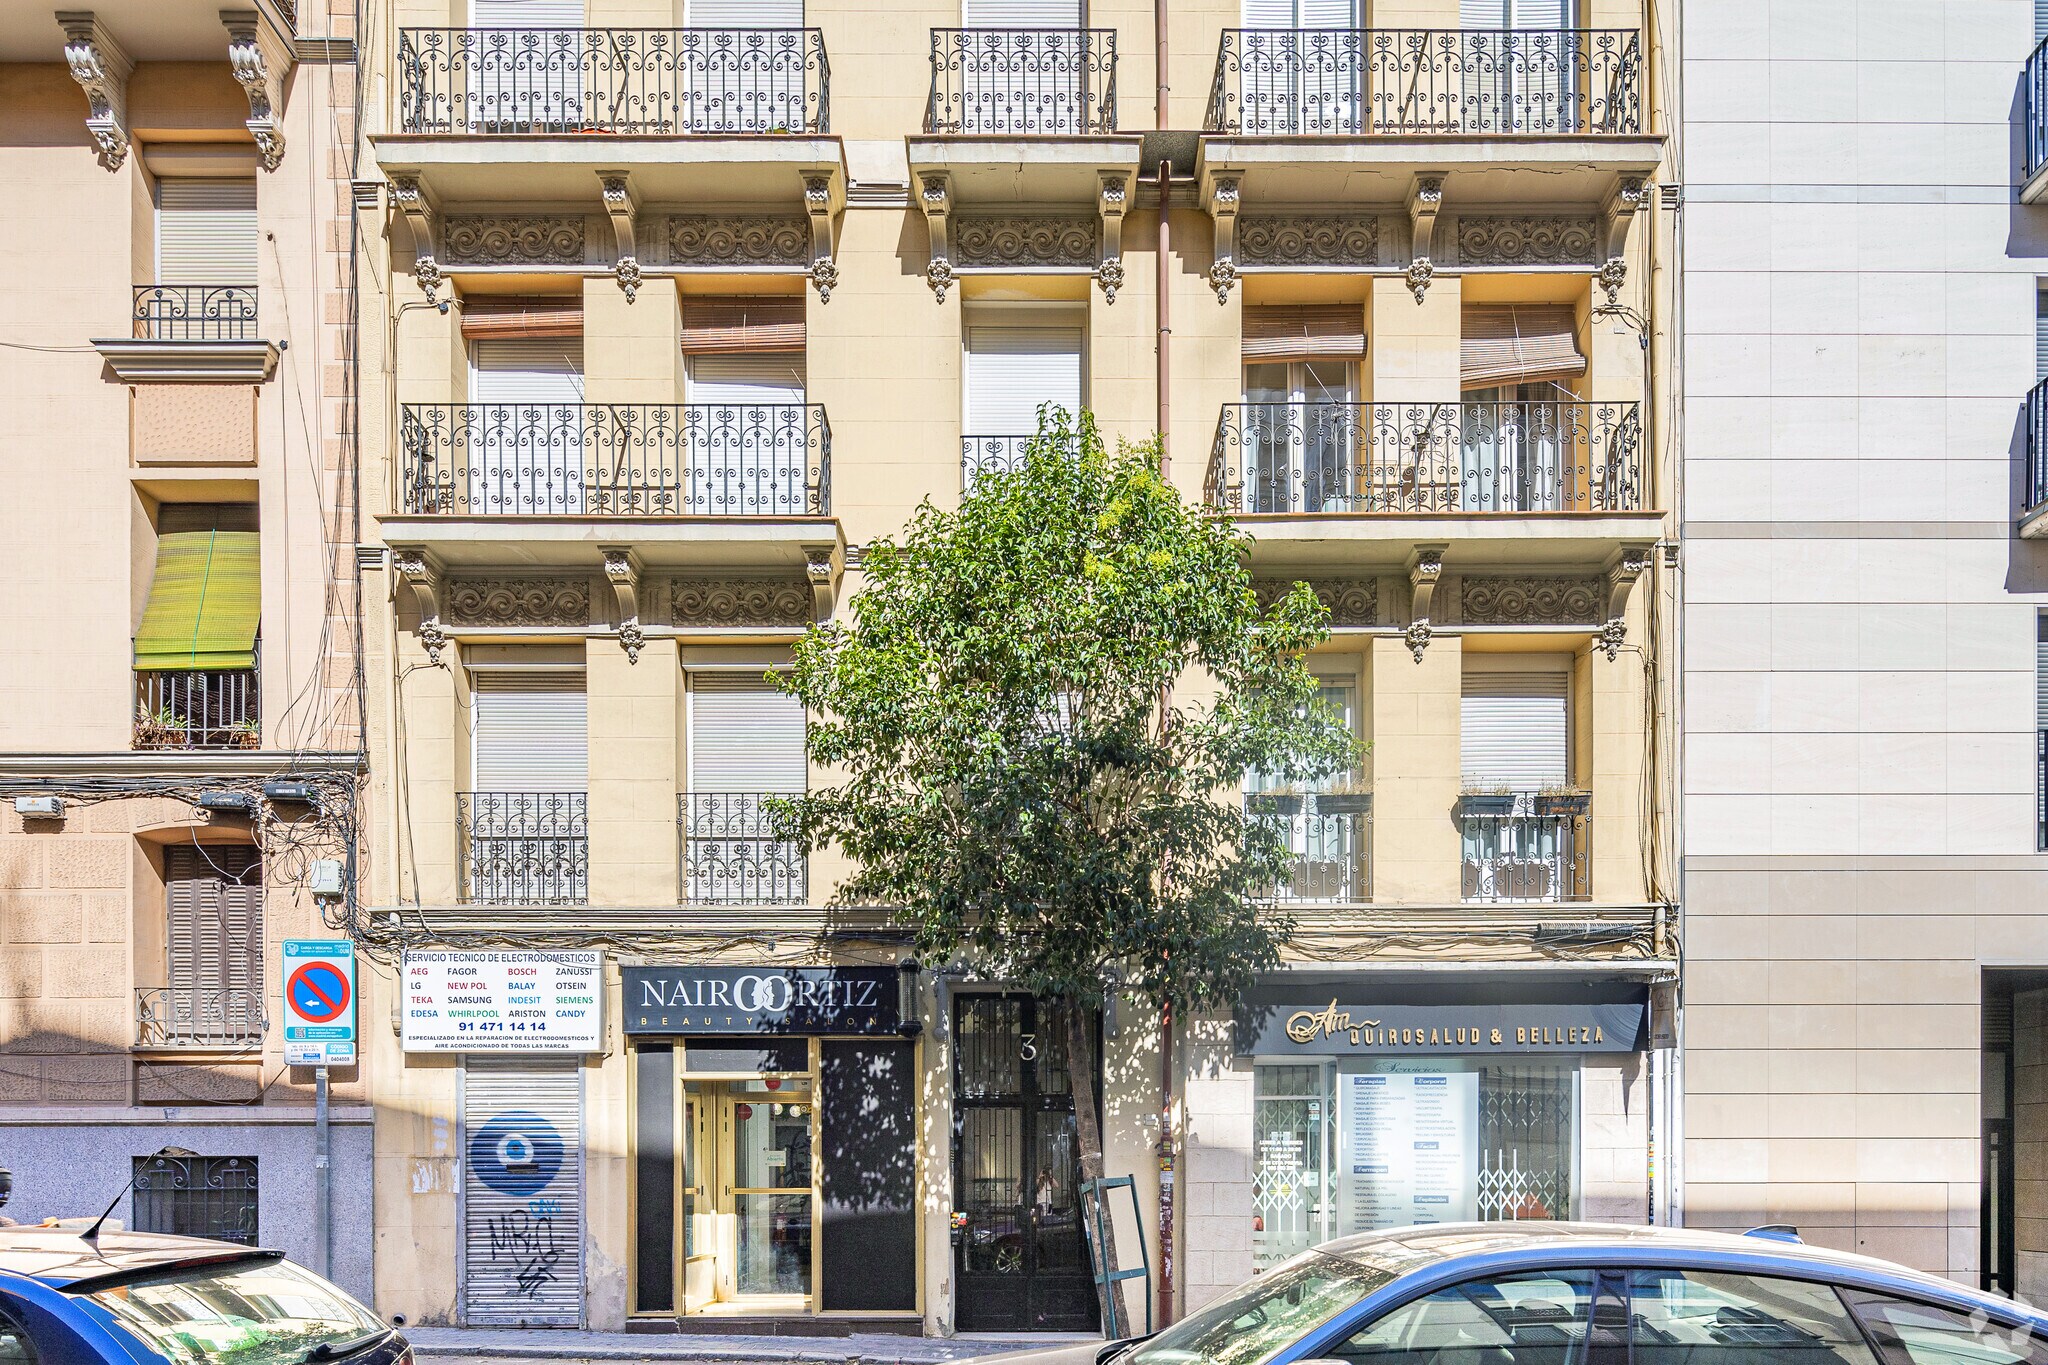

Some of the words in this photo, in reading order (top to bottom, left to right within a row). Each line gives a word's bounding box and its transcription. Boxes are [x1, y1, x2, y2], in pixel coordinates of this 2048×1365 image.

[406, 953, 446, 962] SERVICIO
[449, 953, 486, 962] TECNICO
[488, 953, 500, 962] DE
[501, 953, 596, 962] ELECTRODOMESTICOS
[410, 968, 428, 976] AEG
[447, 968, 478, 976] FAGOR
[508, 968, 537, 976] BOSCH
[556, 968, 592, 976] ZANUSSI
[410, 982, 422, 990] LG
[448, 982, 469, 990] NEW
[470, 982, 488, 990] POL
[508, 982, 536, 990] BALAY
[556, 982, 586, 990] OTSEIN
[410, 996, 433, 1004] TEKA
[448, 996, 492, 1004] SAMSUNG
[508, 996, 542, 1004] INDESIT
[556, 996, 594, 1004] SIEMENS
[410, 1010, 438, 1018] EDESA
[448, 1010, 500, 1018] WHIRLPOOL
[508, 1010, 546, 1018] ARISTON
[556, 1010, 586, 1018] CANDY
[640, 1017, 752, 1026] BEAUTY
[784, 1017, 878, 1026] SALON
[458, 1022, 474, 1031] 91
[480, 1022, 504, 1031] 471
[509, 1022, 525, 1031] 14
[530, 1022, 546, 1031] 14
[1350, 1027, 1480, 1044] QUIROSALUD
[1490, 1027, 1502, 1044] &
[1516, 1026, 1604, 1043] BELLEZA
[1020, 1035, 1037, 1060] 3
[1374, 1061, 1444, 1073] Servicios
